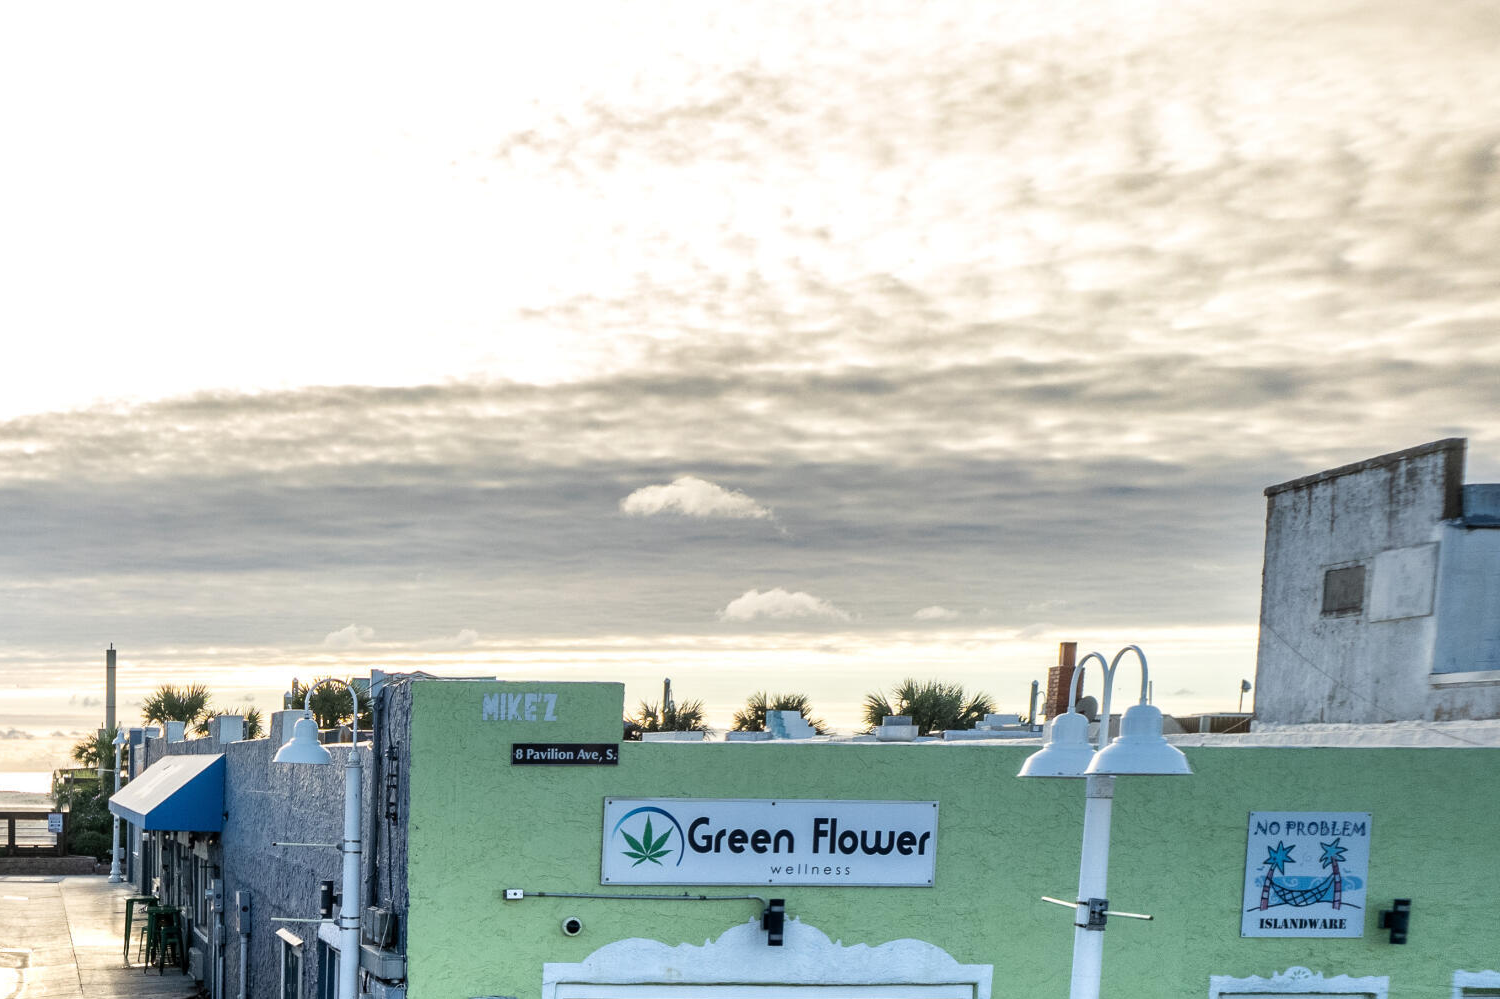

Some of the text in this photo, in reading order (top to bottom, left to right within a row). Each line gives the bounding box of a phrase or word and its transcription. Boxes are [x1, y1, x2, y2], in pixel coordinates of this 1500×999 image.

[482, 692, 558, 722] MIKE'Z
[515, 748, 618, 763] 8 Pavilion Ave, S.
[688, 816, 931, 856] Green Flower
[1254, 821, 1366, 837] NO PROBLEM
[770, 863, 851, 876] wellness
[1259, 918, 1347, 930] ISLANDWARE
